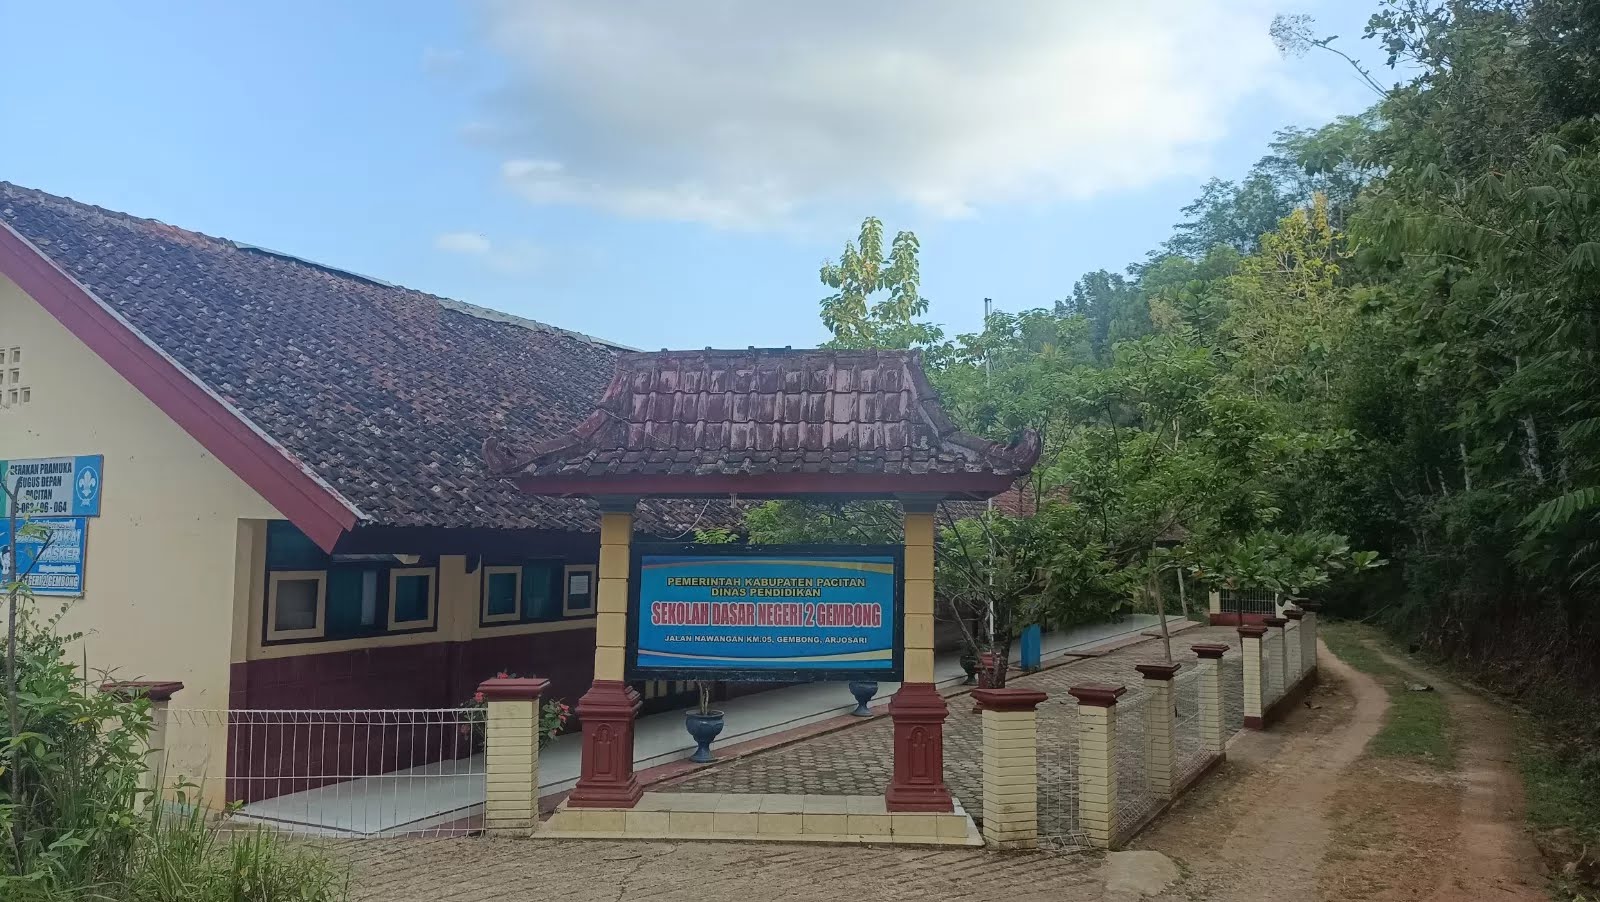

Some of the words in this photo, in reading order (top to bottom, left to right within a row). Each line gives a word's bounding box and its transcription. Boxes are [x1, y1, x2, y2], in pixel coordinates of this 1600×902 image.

[10, 463, 40, 475] GERAKAN
[40, 462, 72, 474] PRAMUKA
[41, 475, 62, 487] DEPAN
[48, 574, 79, 589] GEMBONG
[667, 577, 741, 586] PEMERINTAH
[745, 578, 813, 587] KABUPATEN
[816, 578, 866, 587] PACITAN
[711, 588, 747, 597] DINAS
[750, 588, 821, 597] PENDIDIKAN
[651, 601, 710, 626] SEKOLAH
[711, 602, 756, 626] DASAR
[757, 602, 803, 626] NEGERI
[804, 602, 816, 627] 2
[816, 602, 882, 627] GEMBONG
[694, 635, 744, 643] NAWANGAN
